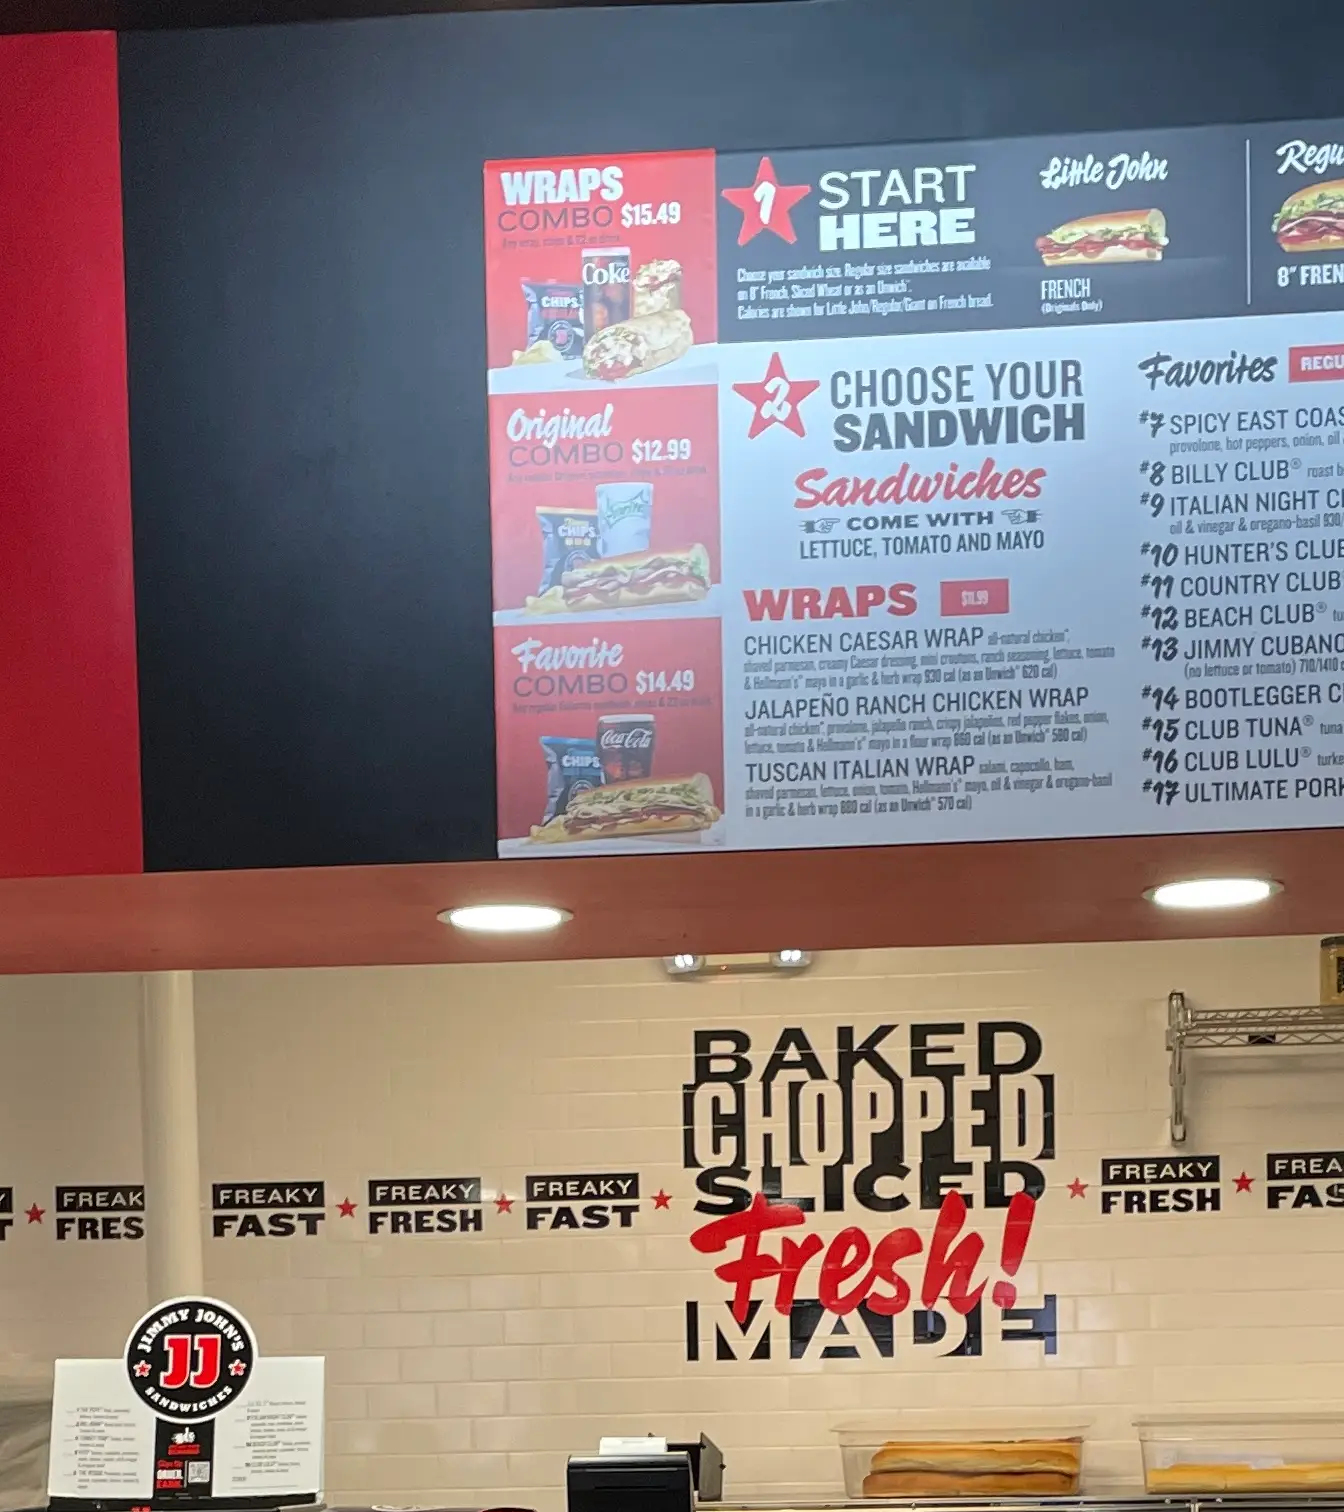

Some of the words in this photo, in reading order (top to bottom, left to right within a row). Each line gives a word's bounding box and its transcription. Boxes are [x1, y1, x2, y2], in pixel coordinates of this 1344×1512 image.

[501, 166, 623, 205] WRAPS
[819, 165, 975, 210] START
[1040, 154, 1102, 188] Little
[1106, 152, 1167, 190] John
[498, 206, 613, 232] COMBO
[621, 202, 681, 225] $15.49
[820, 208, 974, 250] HERE
[1041, 279, 1090, 300] FRENCH
[831, 365, 974, 410] CHOOSE
[985, 360, 1083, 400] YOUR
[1138, 351, 1278, 390] Favorites
[507, 403, 614, 448] Original
[833, 403, 1085, 453] SANDWICH
[1170, 413, 1230, 435] SPICY
[1237, 410, 1289, 431] EAST
[510, 442, 624, 467] COMBO
[632, 439, 691, 464] $12.99
[793, 457, 1047, 509] Sandwiches
[847, 515, 918, 530] COME
[926, 511, 994, 526] WITH
[800, 537, 878, 559] LETTUCE,
[884, 535, 951, 555] TOMATO
[957, 533, 990, 552] AND
[997, 530, 1044, 550] MAYO
[742, 583, 917, 621] WRAPS
[1180, 575, 1280, 597] COUNTRY
[512, 637, 624, 673] Favorite
[744, 632, 833, 656] CHICKEN
[839, 630, 918, 652] CAESAR
[924, 627, 984, 648] WRAP
[513, 673, 627, 697] COMBO
[636, 670, 695, 695] $14.49
[745, 693, 849, 720] JALAPEÑO
[856, 694, 925, 715] RANCH
[933, 690, 1022, 712] CHICKEN
[1029, 687, 1089, 708] WRAP
[1185, 779, 1289, 804] ULTIMATE
[694, 1022, 1043, 1082] BAKED
[683, 1074, 1055, 1168] CHOPPED
[693, 1161, 1046, 1215] SLICED
[690, 1190, 1036, 1323] Fresh!
[138, 1309, 190, 1353] JIMMY
[195, 1309, 245, 1352] JOHN'S
[686, 1294, 1056, 1361] MADE
[160, 1334, 221, 1389] JJ
[145, 1385, 233, 1412] SANDWICHES
